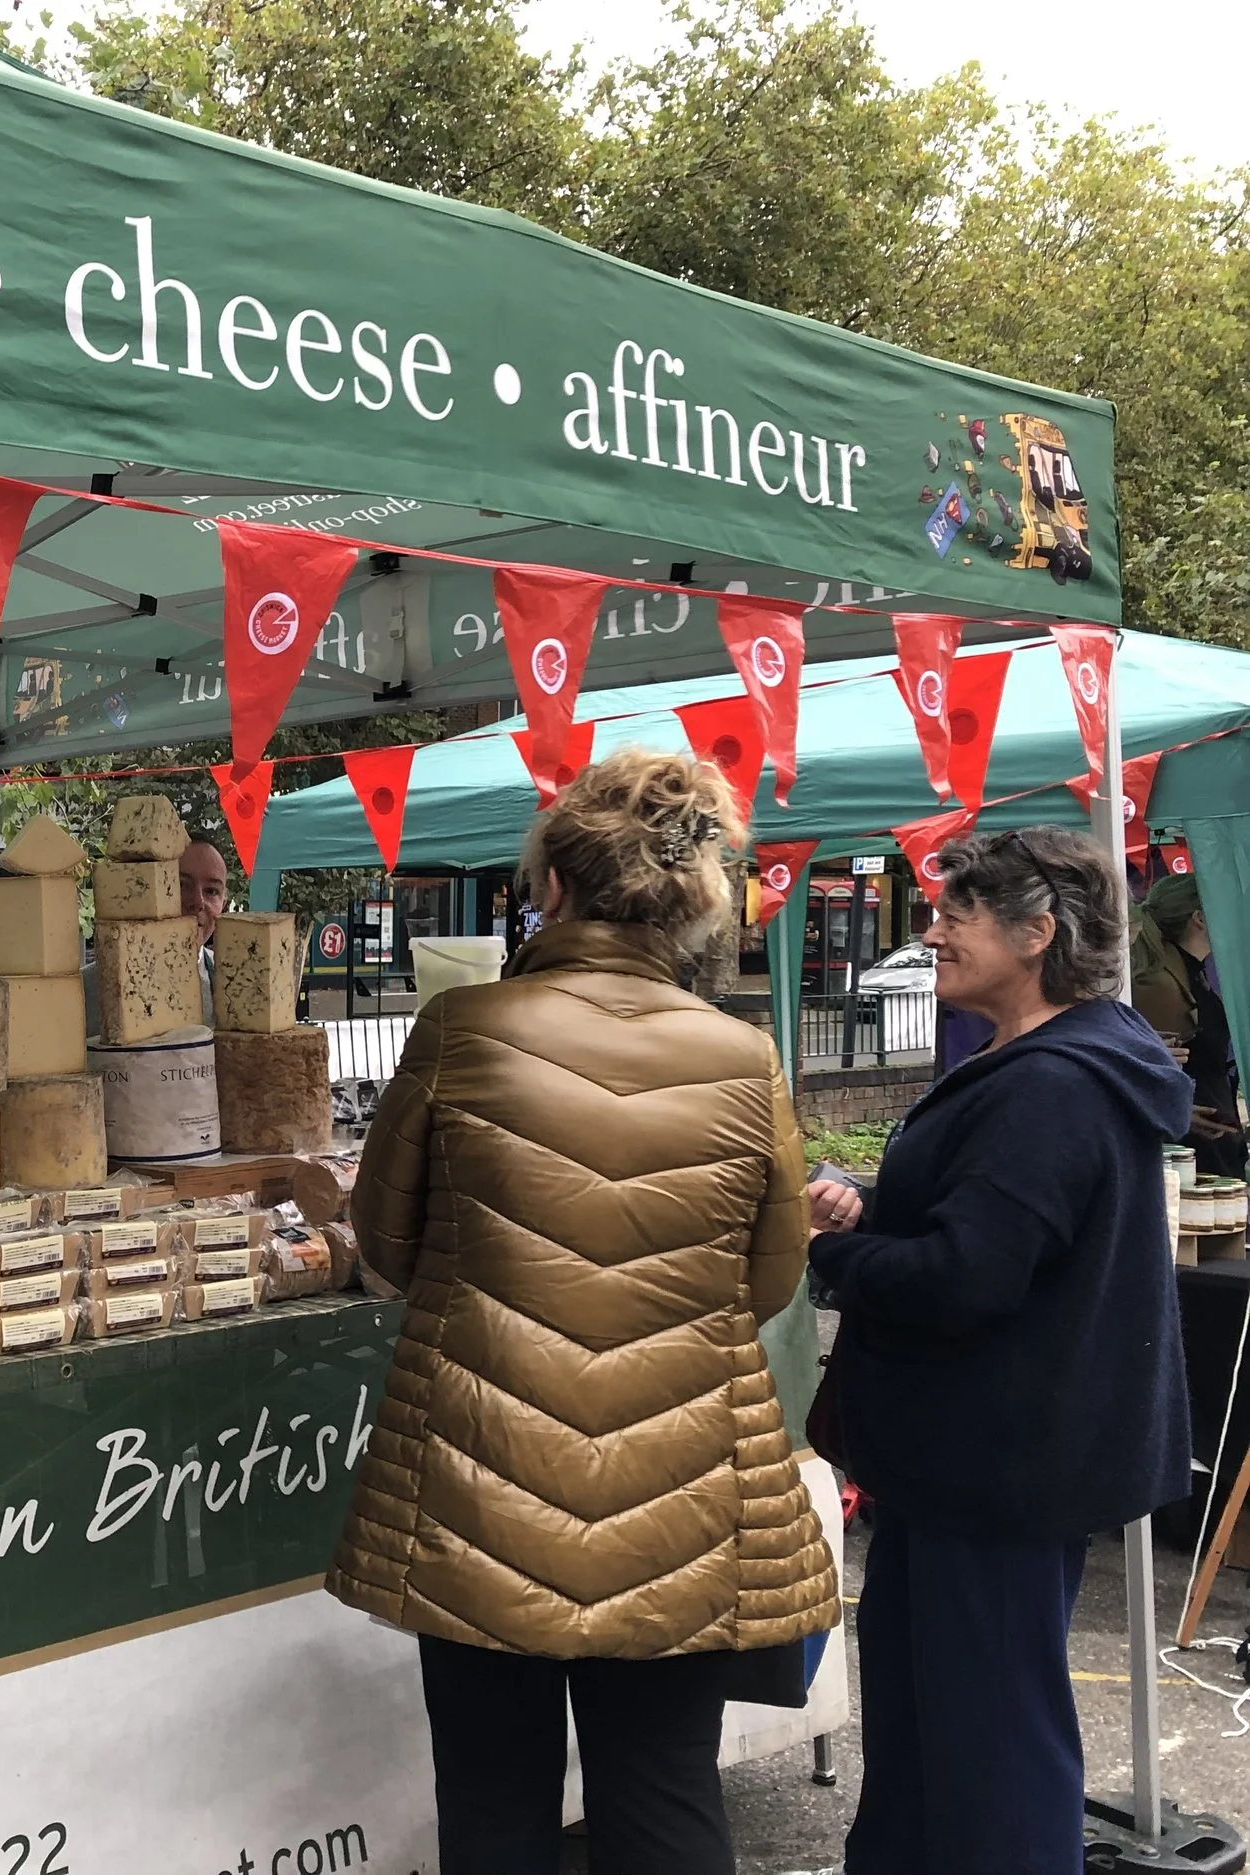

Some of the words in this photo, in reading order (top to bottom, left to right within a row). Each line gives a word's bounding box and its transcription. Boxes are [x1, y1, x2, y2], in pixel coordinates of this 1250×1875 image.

[65, 216, 453, 421] cheese
[563, 340, 866, 513] affineur
[323, 930, 342, 954] £1
[85, 1384, 374, 1543] British
